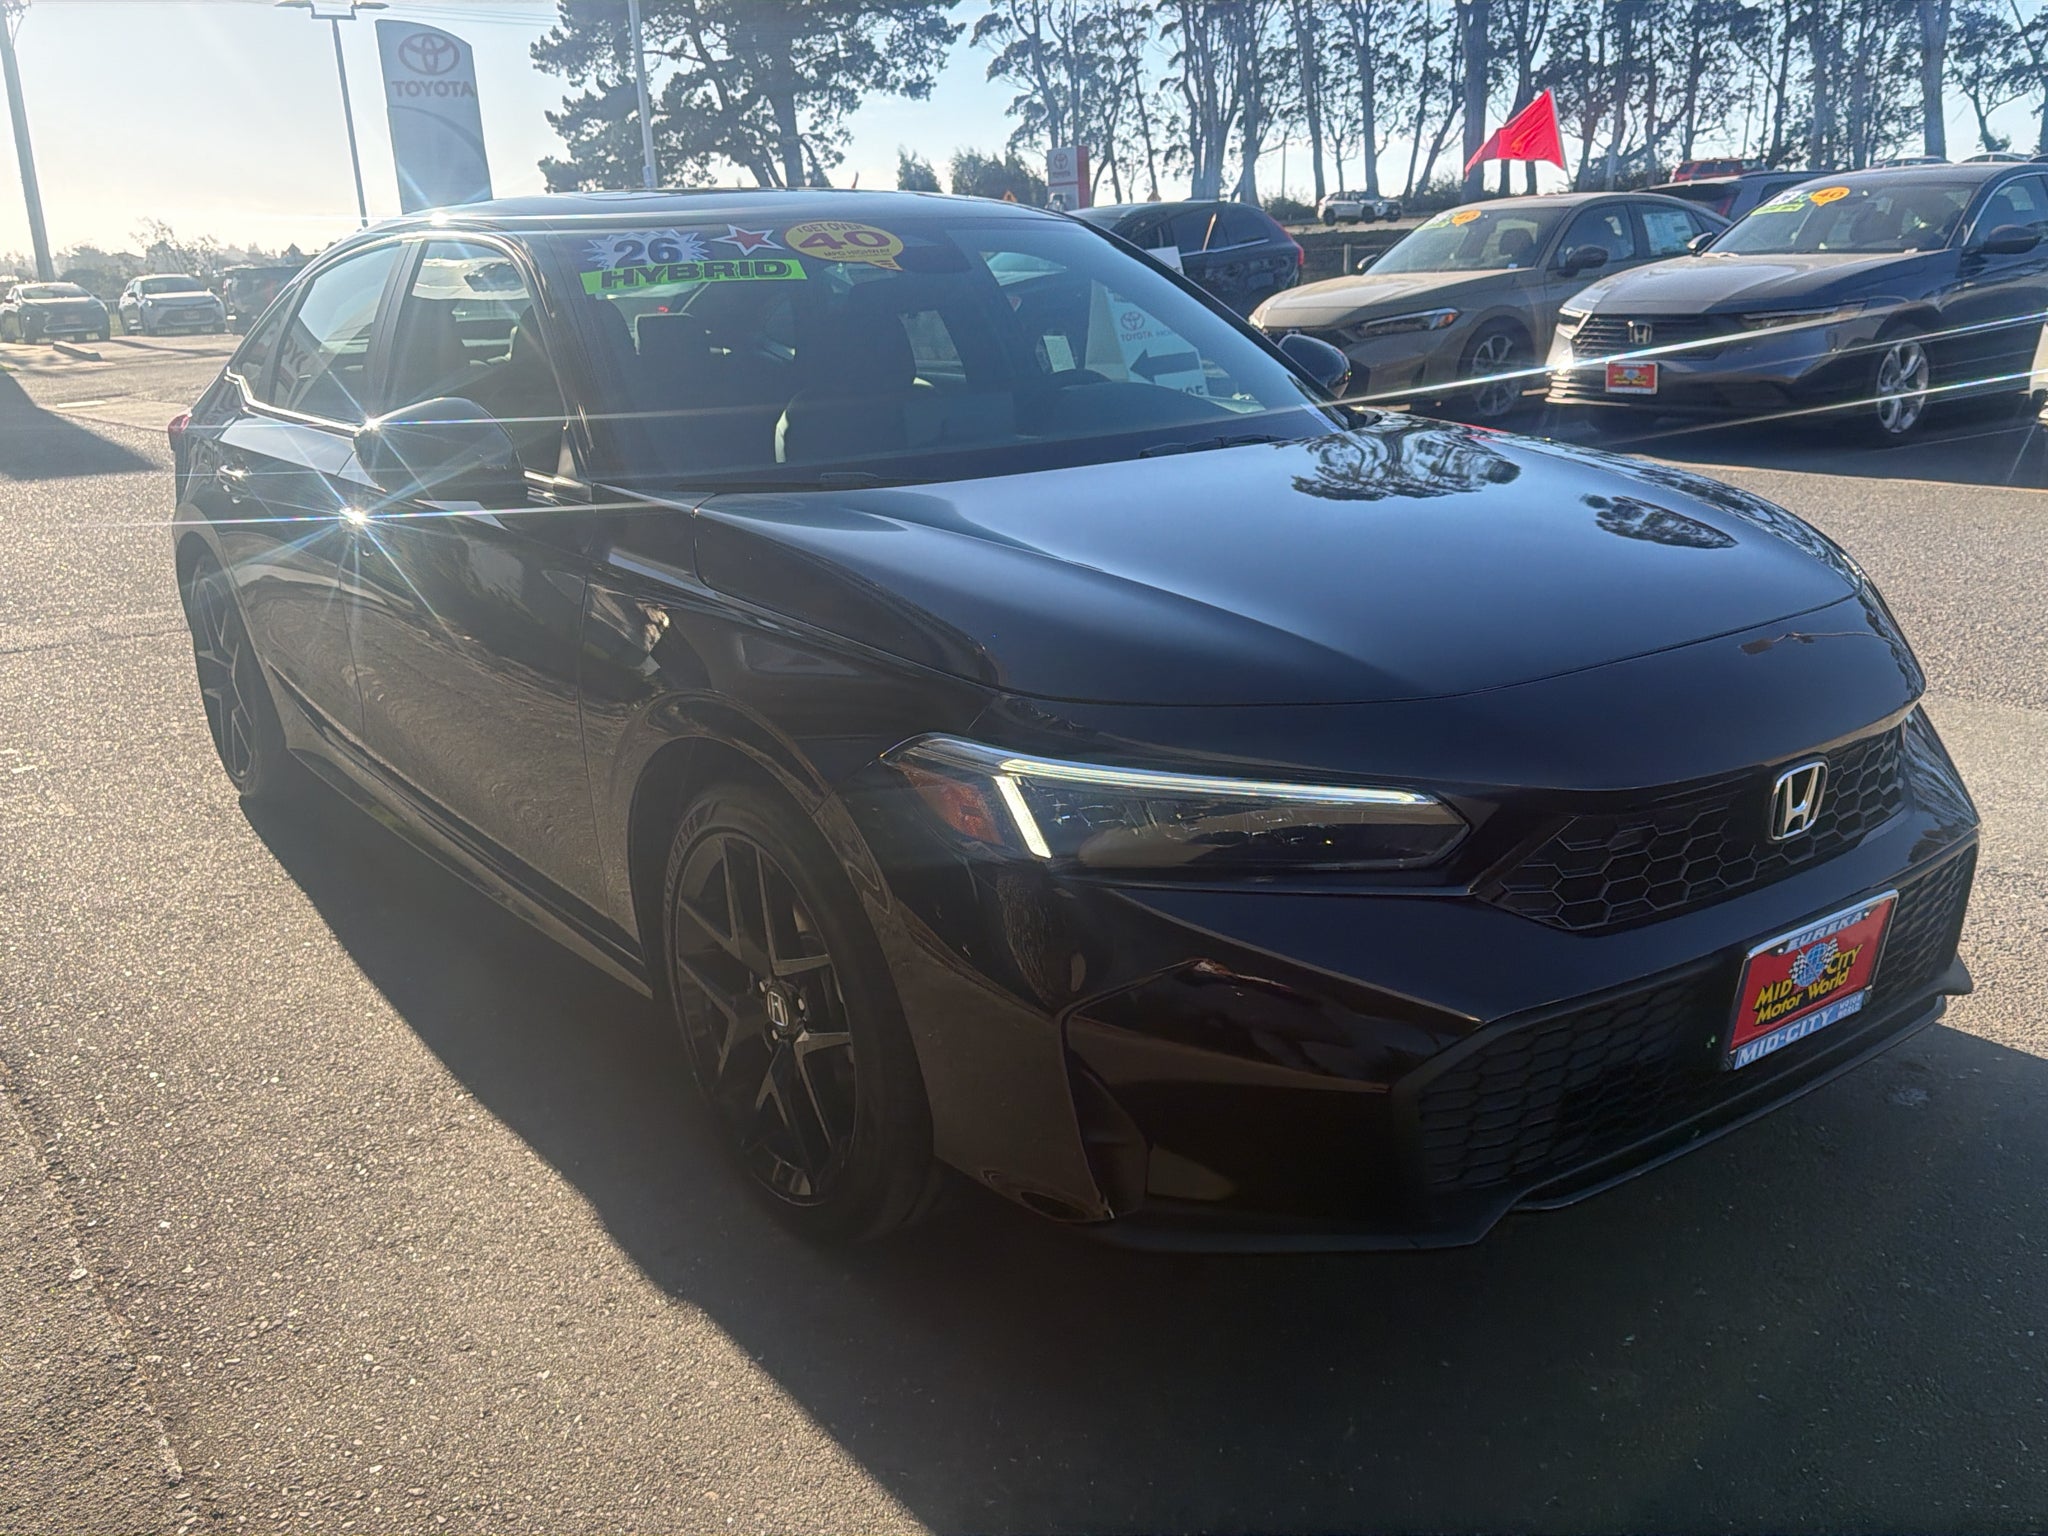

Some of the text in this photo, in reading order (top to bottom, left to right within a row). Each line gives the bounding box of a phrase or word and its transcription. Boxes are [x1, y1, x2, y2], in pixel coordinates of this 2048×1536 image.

[391, 79, 475, 98] TOYOTA
[798, 231, 891, 249] 40
[827, 222, 865, 231] OVER
[613, 237, 683, 267] 26
[601, 260, 791, 289] HYBRID
[1120, 330, 1152, 342] TOYOTA
[1788, 911, 1863, 950] EUREKA
[1753, 944, 1864, 1010] MID CITY
[1754, 991, 1804, 1026] Motor
[1807, 966, 1850, 1001] World
